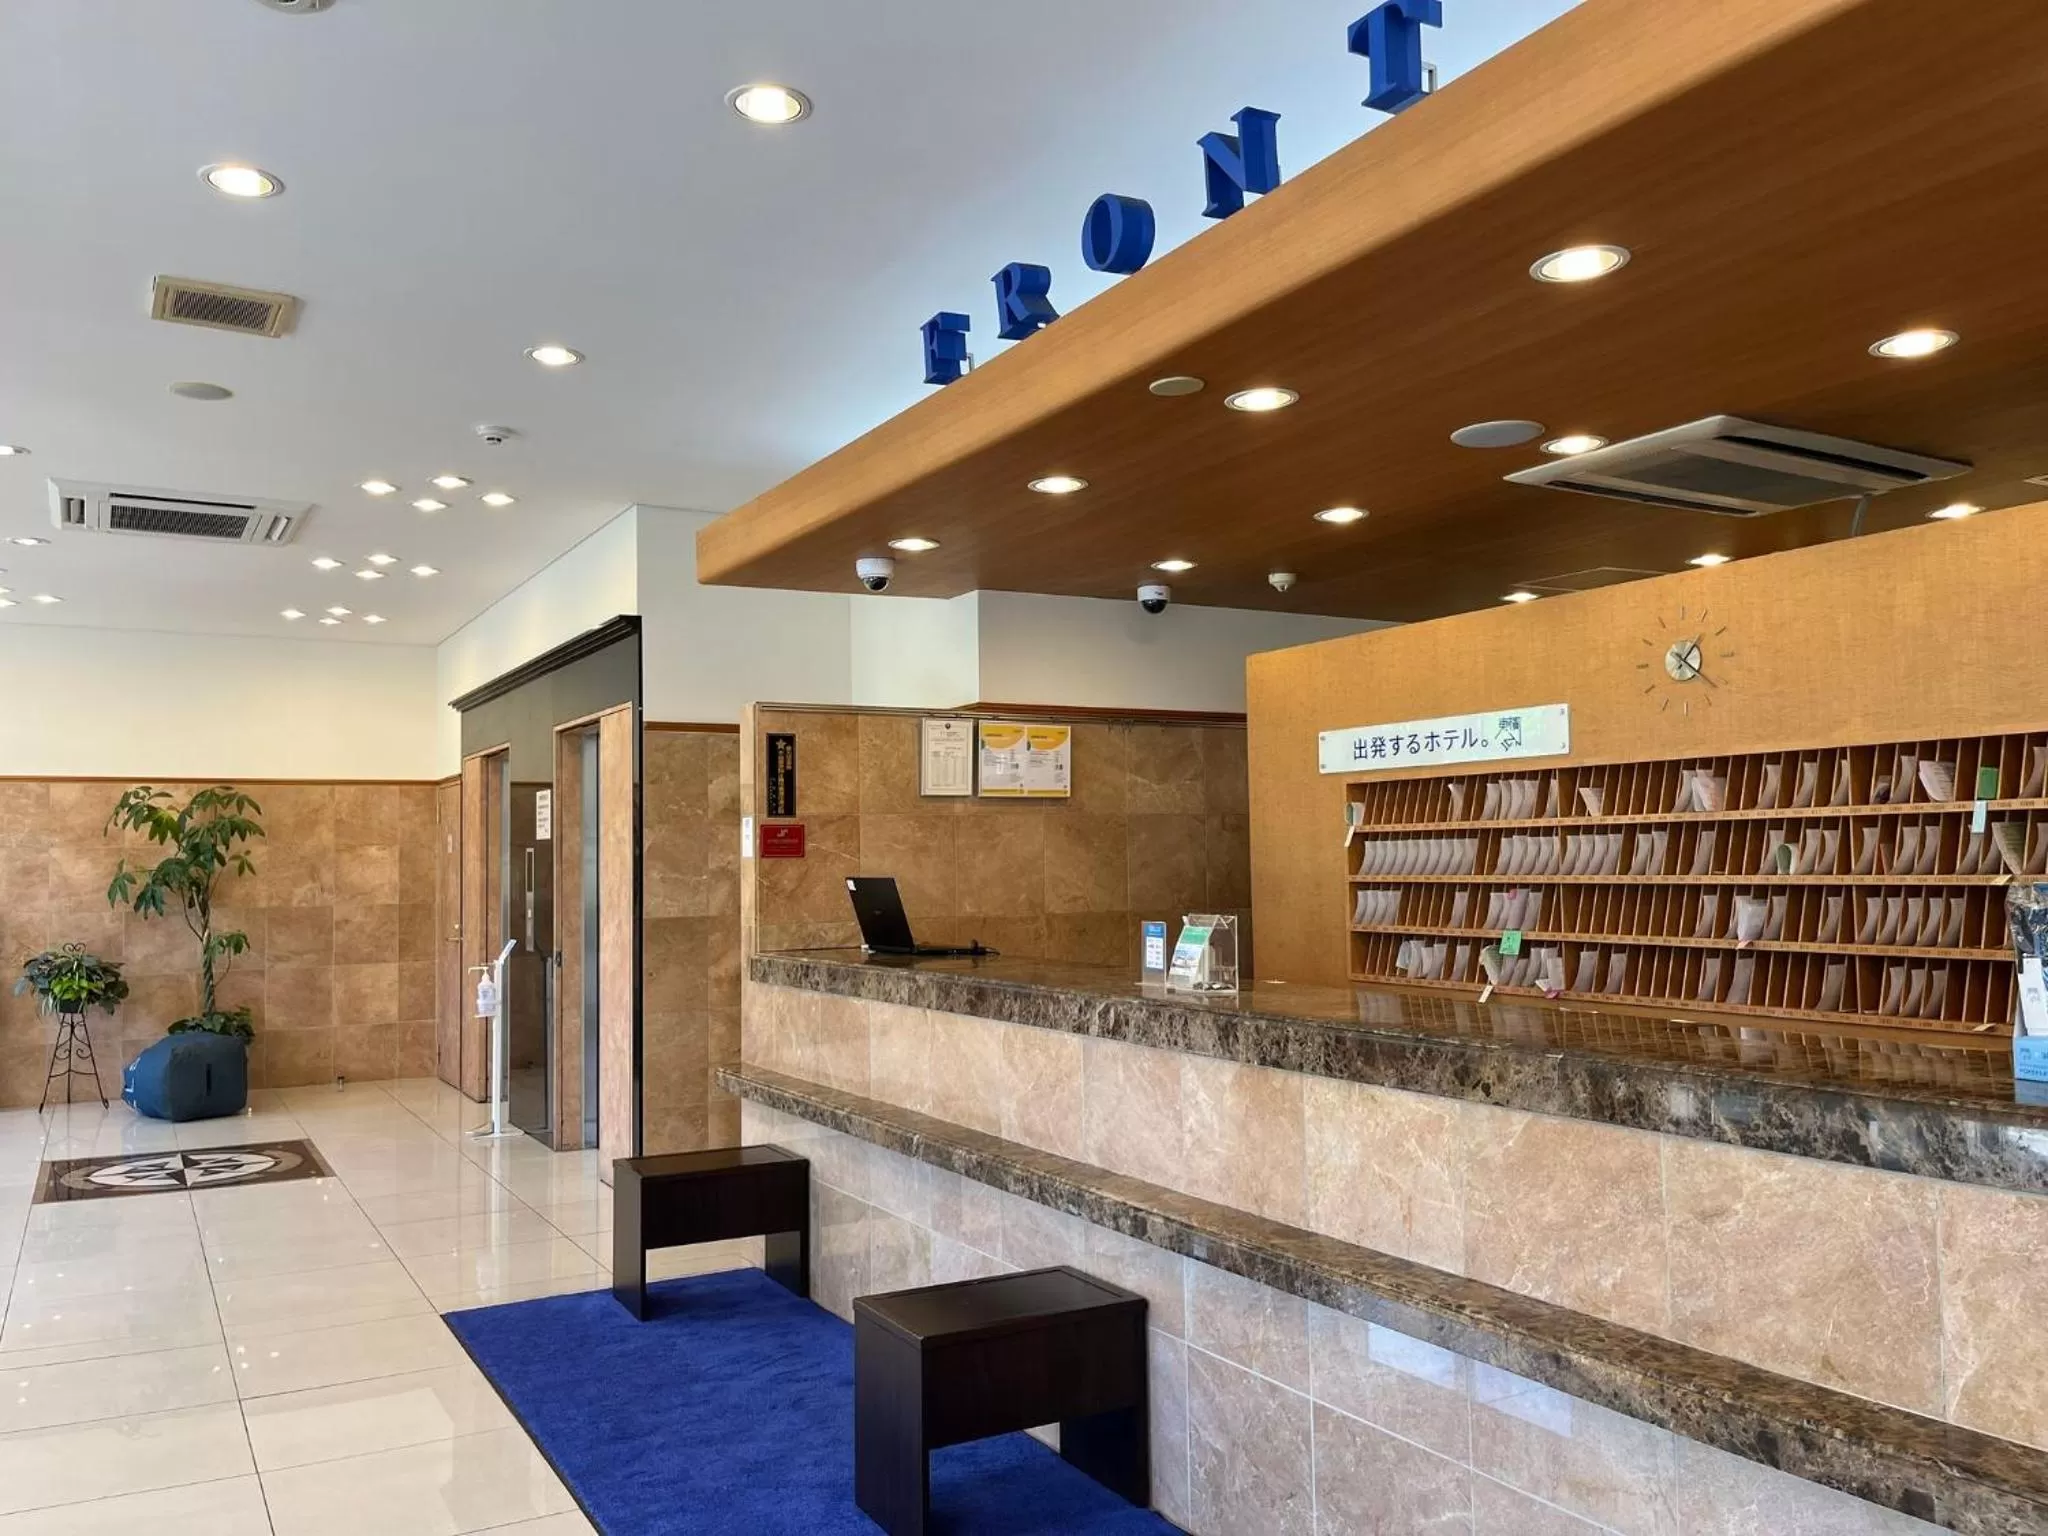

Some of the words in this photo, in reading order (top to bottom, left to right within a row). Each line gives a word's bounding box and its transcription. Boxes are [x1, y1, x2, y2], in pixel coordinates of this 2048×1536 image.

[920, 0, 1442, 385] FRONT
[1352, 727, 1489, 761] 出発するホテル。
